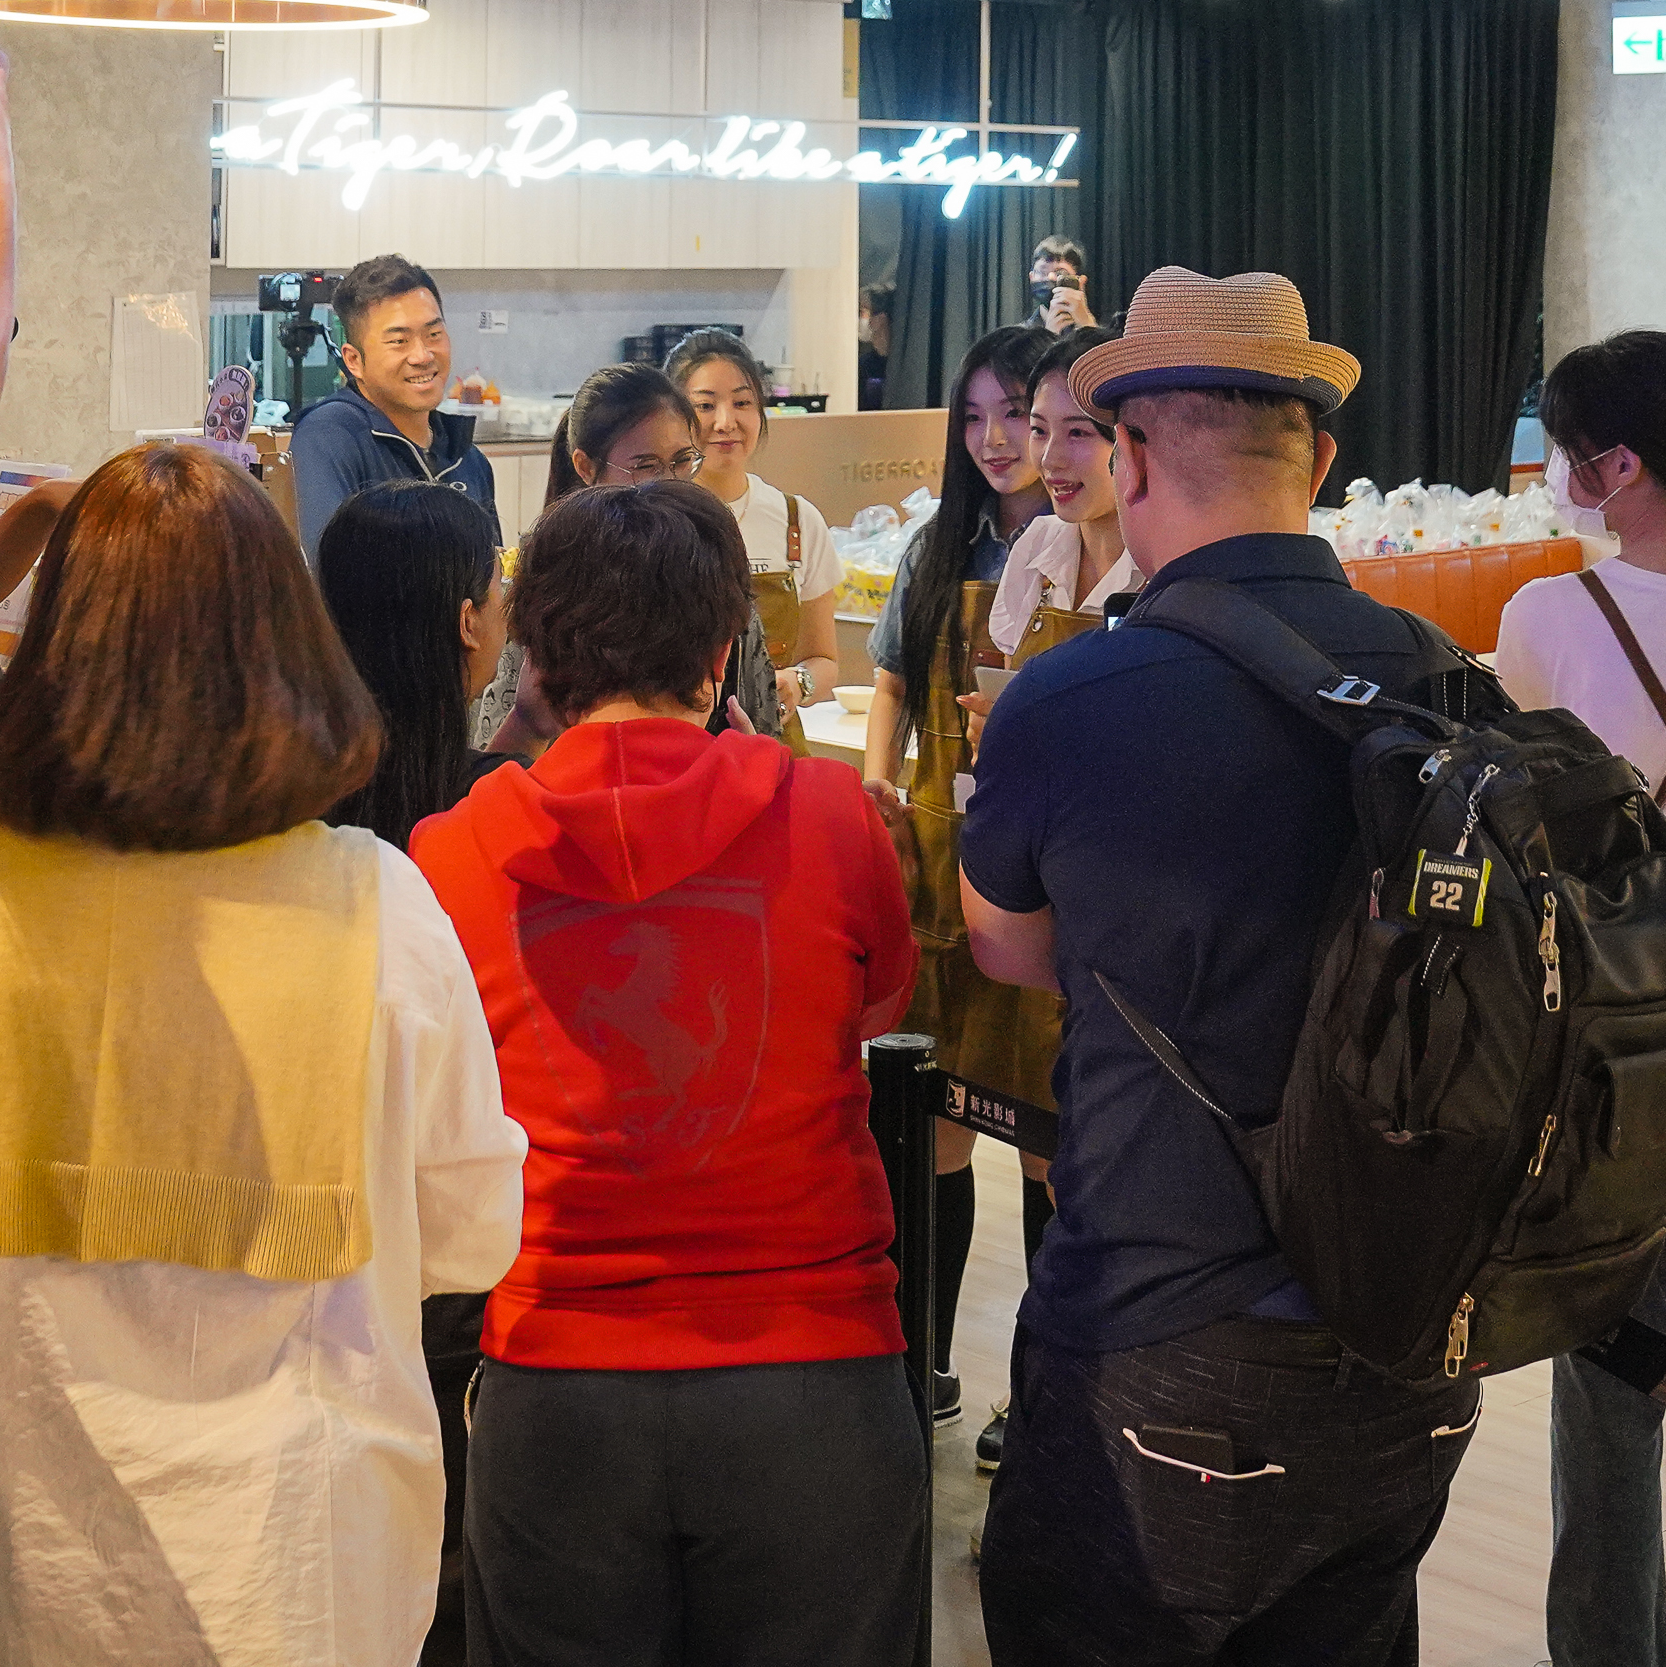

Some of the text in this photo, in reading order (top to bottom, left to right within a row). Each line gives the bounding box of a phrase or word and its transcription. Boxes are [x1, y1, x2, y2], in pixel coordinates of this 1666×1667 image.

[1423, 861, 1479, 880] DREAMERS
[1429, 880, 1463, 911] 22
[970, 1094, 1015, 1127] 新光影城
